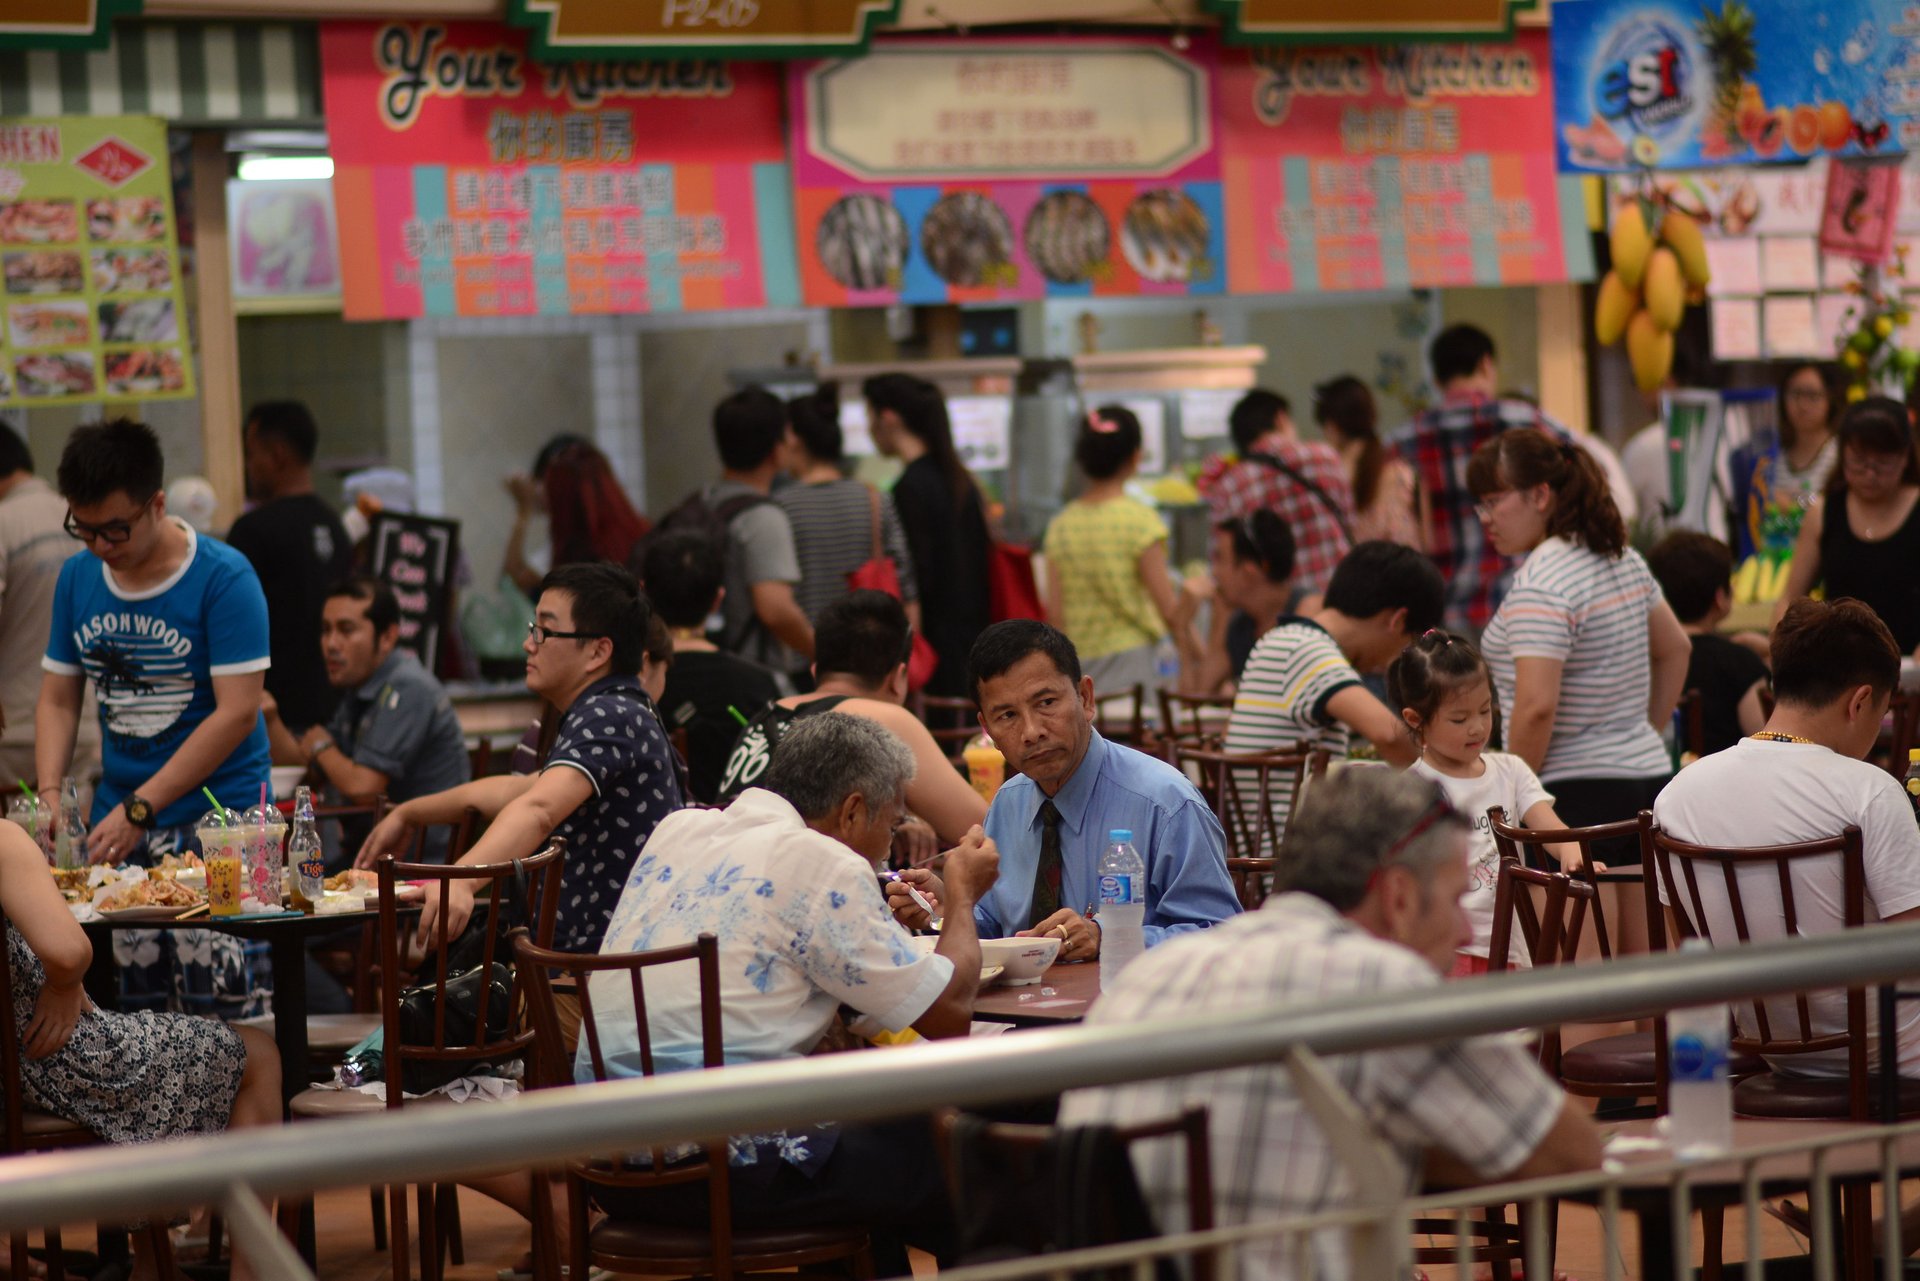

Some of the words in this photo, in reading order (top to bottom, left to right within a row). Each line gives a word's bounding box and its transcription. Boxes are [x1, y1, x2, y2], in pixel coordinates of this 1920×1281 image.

[378, 26, 523, 130] Your
[73, 612, 193, 658] JASONWOOD
[303, 863, 324, 878] Tige
